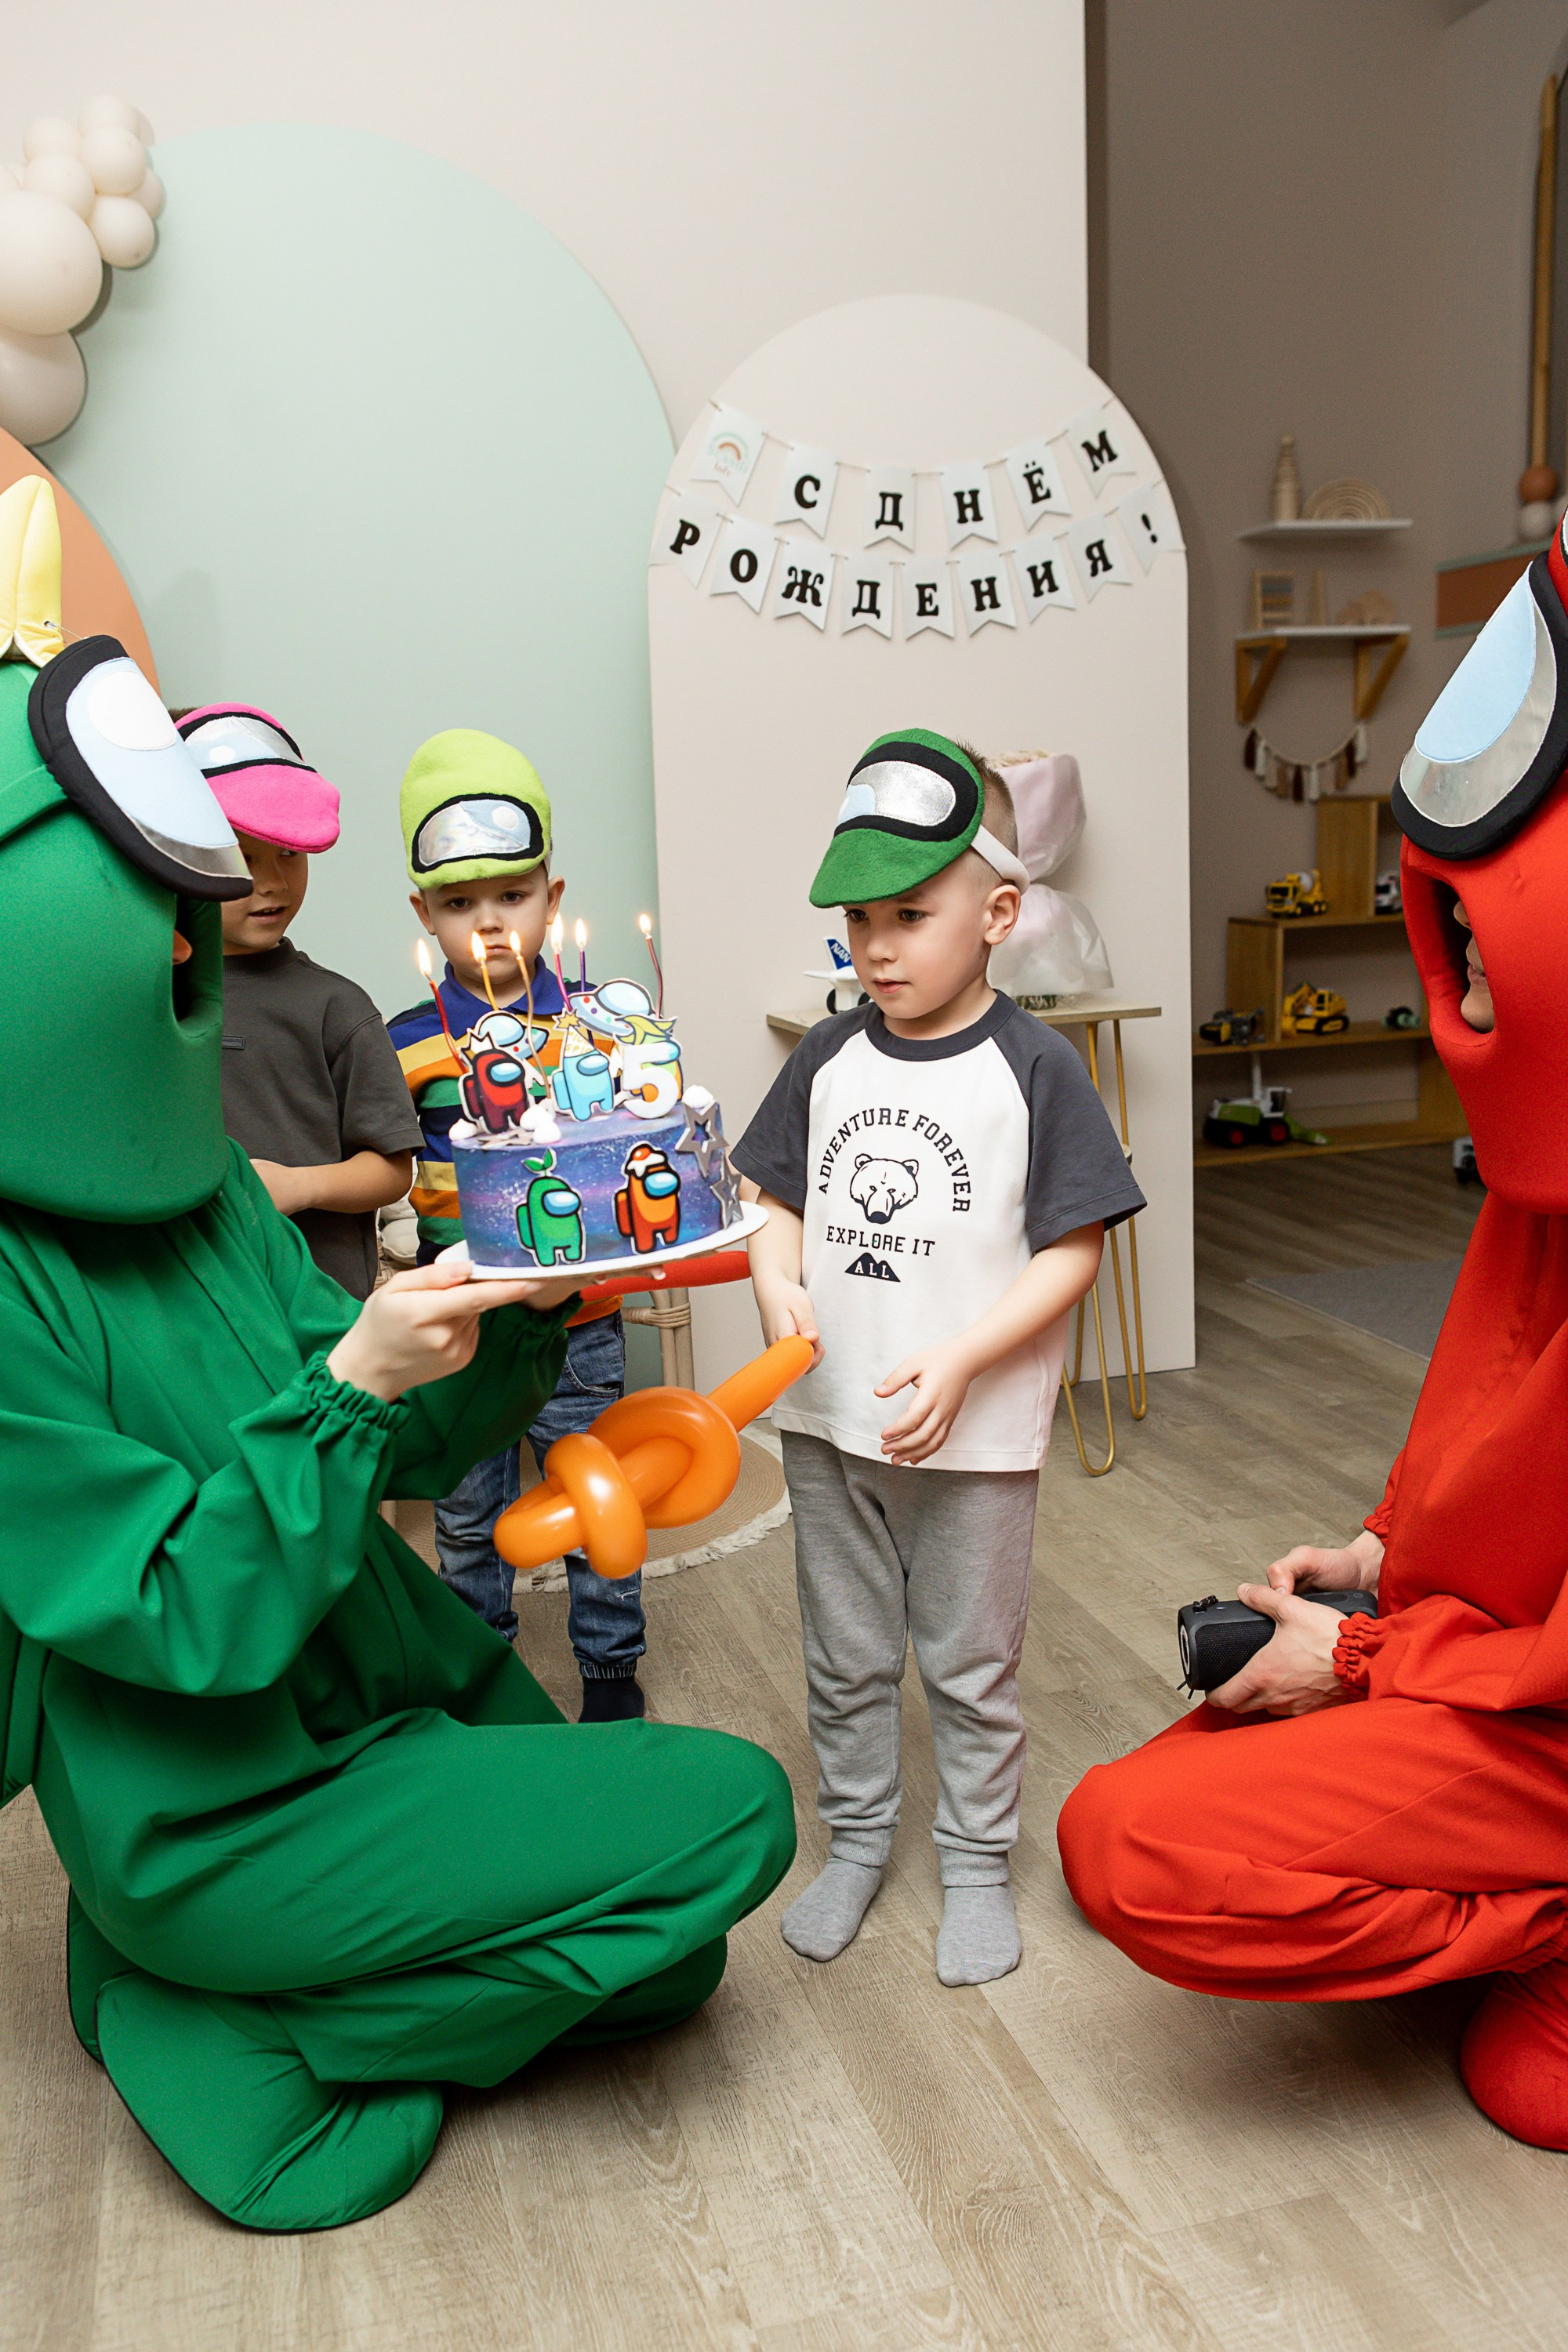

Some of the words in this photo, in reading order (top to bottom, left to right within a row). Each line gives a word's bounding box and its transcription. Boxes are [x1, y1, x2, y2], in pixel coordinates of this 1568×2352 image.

[793, 474, 822, 510] С
[874, 429, 1119, 532] ДНЁМ
[669, 513, 1158, 620] РОЖДЕНИЯ!
[622, 1041, 680, 1120] 5
[818, 1108, 909, 1196] ADVENTURE
[912, 1113, 972, 1213] FOREVER
[826, 1225, 906, 1254] EXPLORE
[912, 1238, 936, 1257] IT
[854, 1261, 890, 1279] ALL
